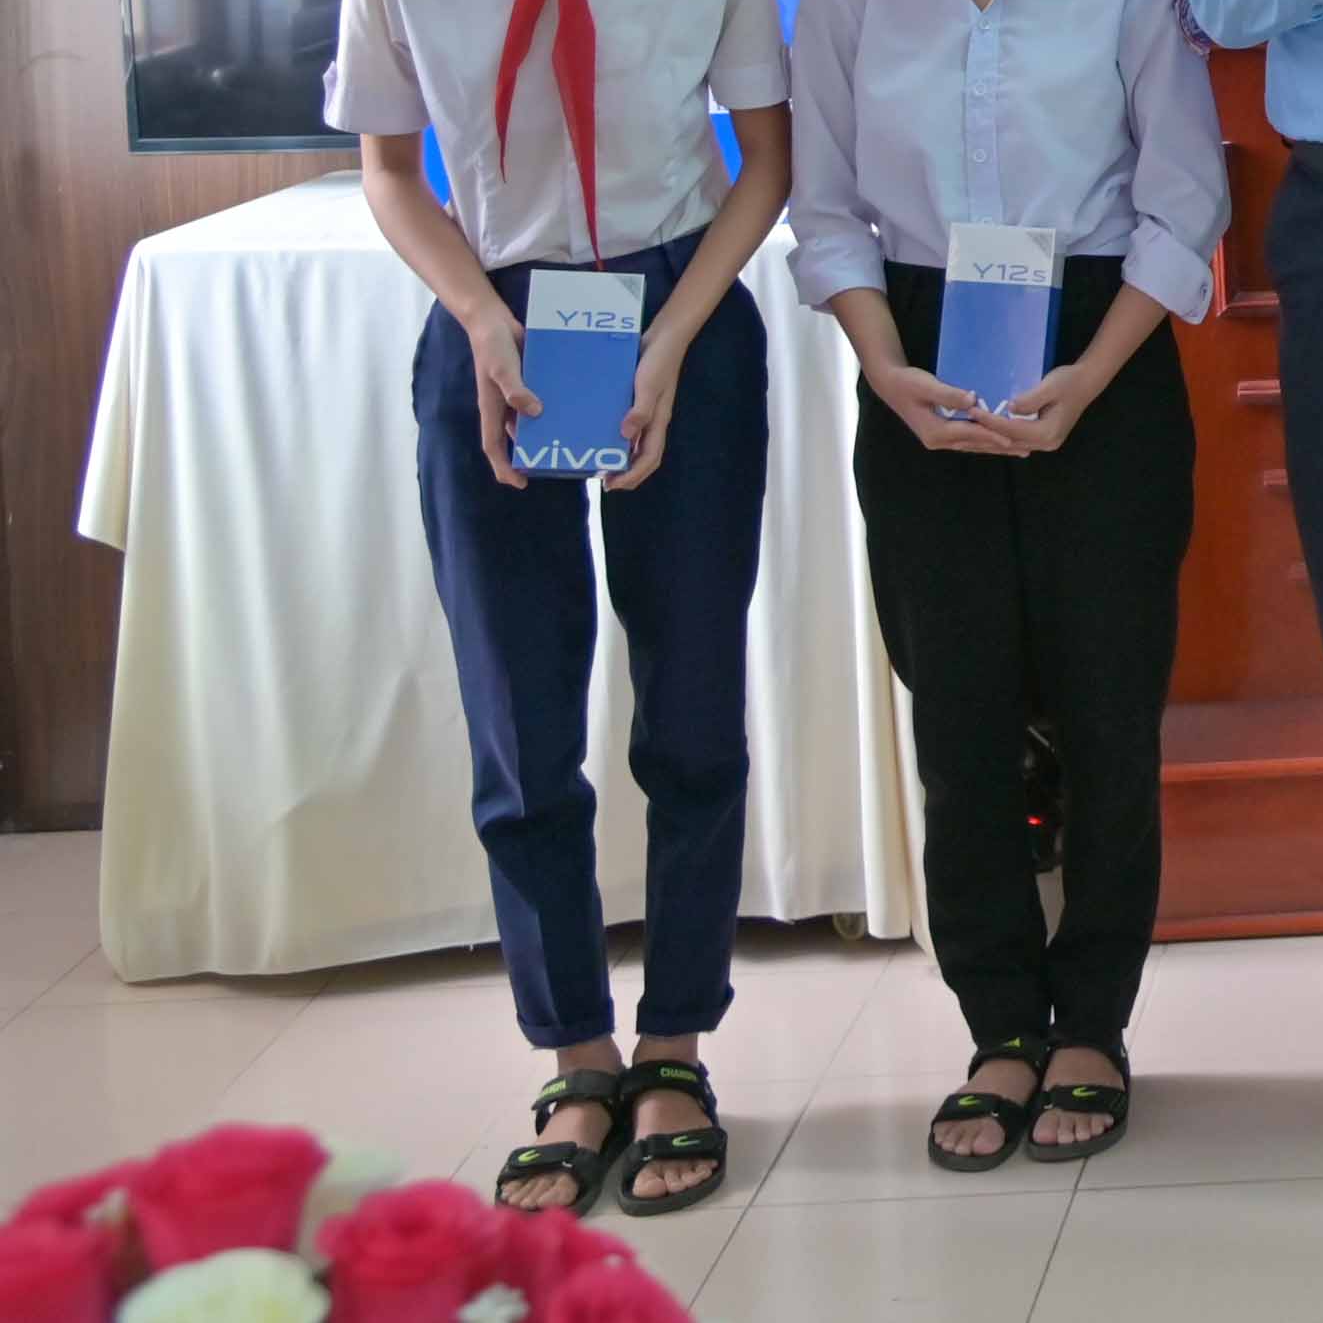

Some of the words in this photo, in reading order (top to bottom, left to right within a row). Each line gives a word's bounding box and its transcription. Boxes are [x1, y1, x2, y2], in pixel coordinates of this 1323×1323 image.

[972, 262, 1048, 283] Y12s
[556, 309, 636, 329] Y12s
[515, 438, 629, 470] vivo
